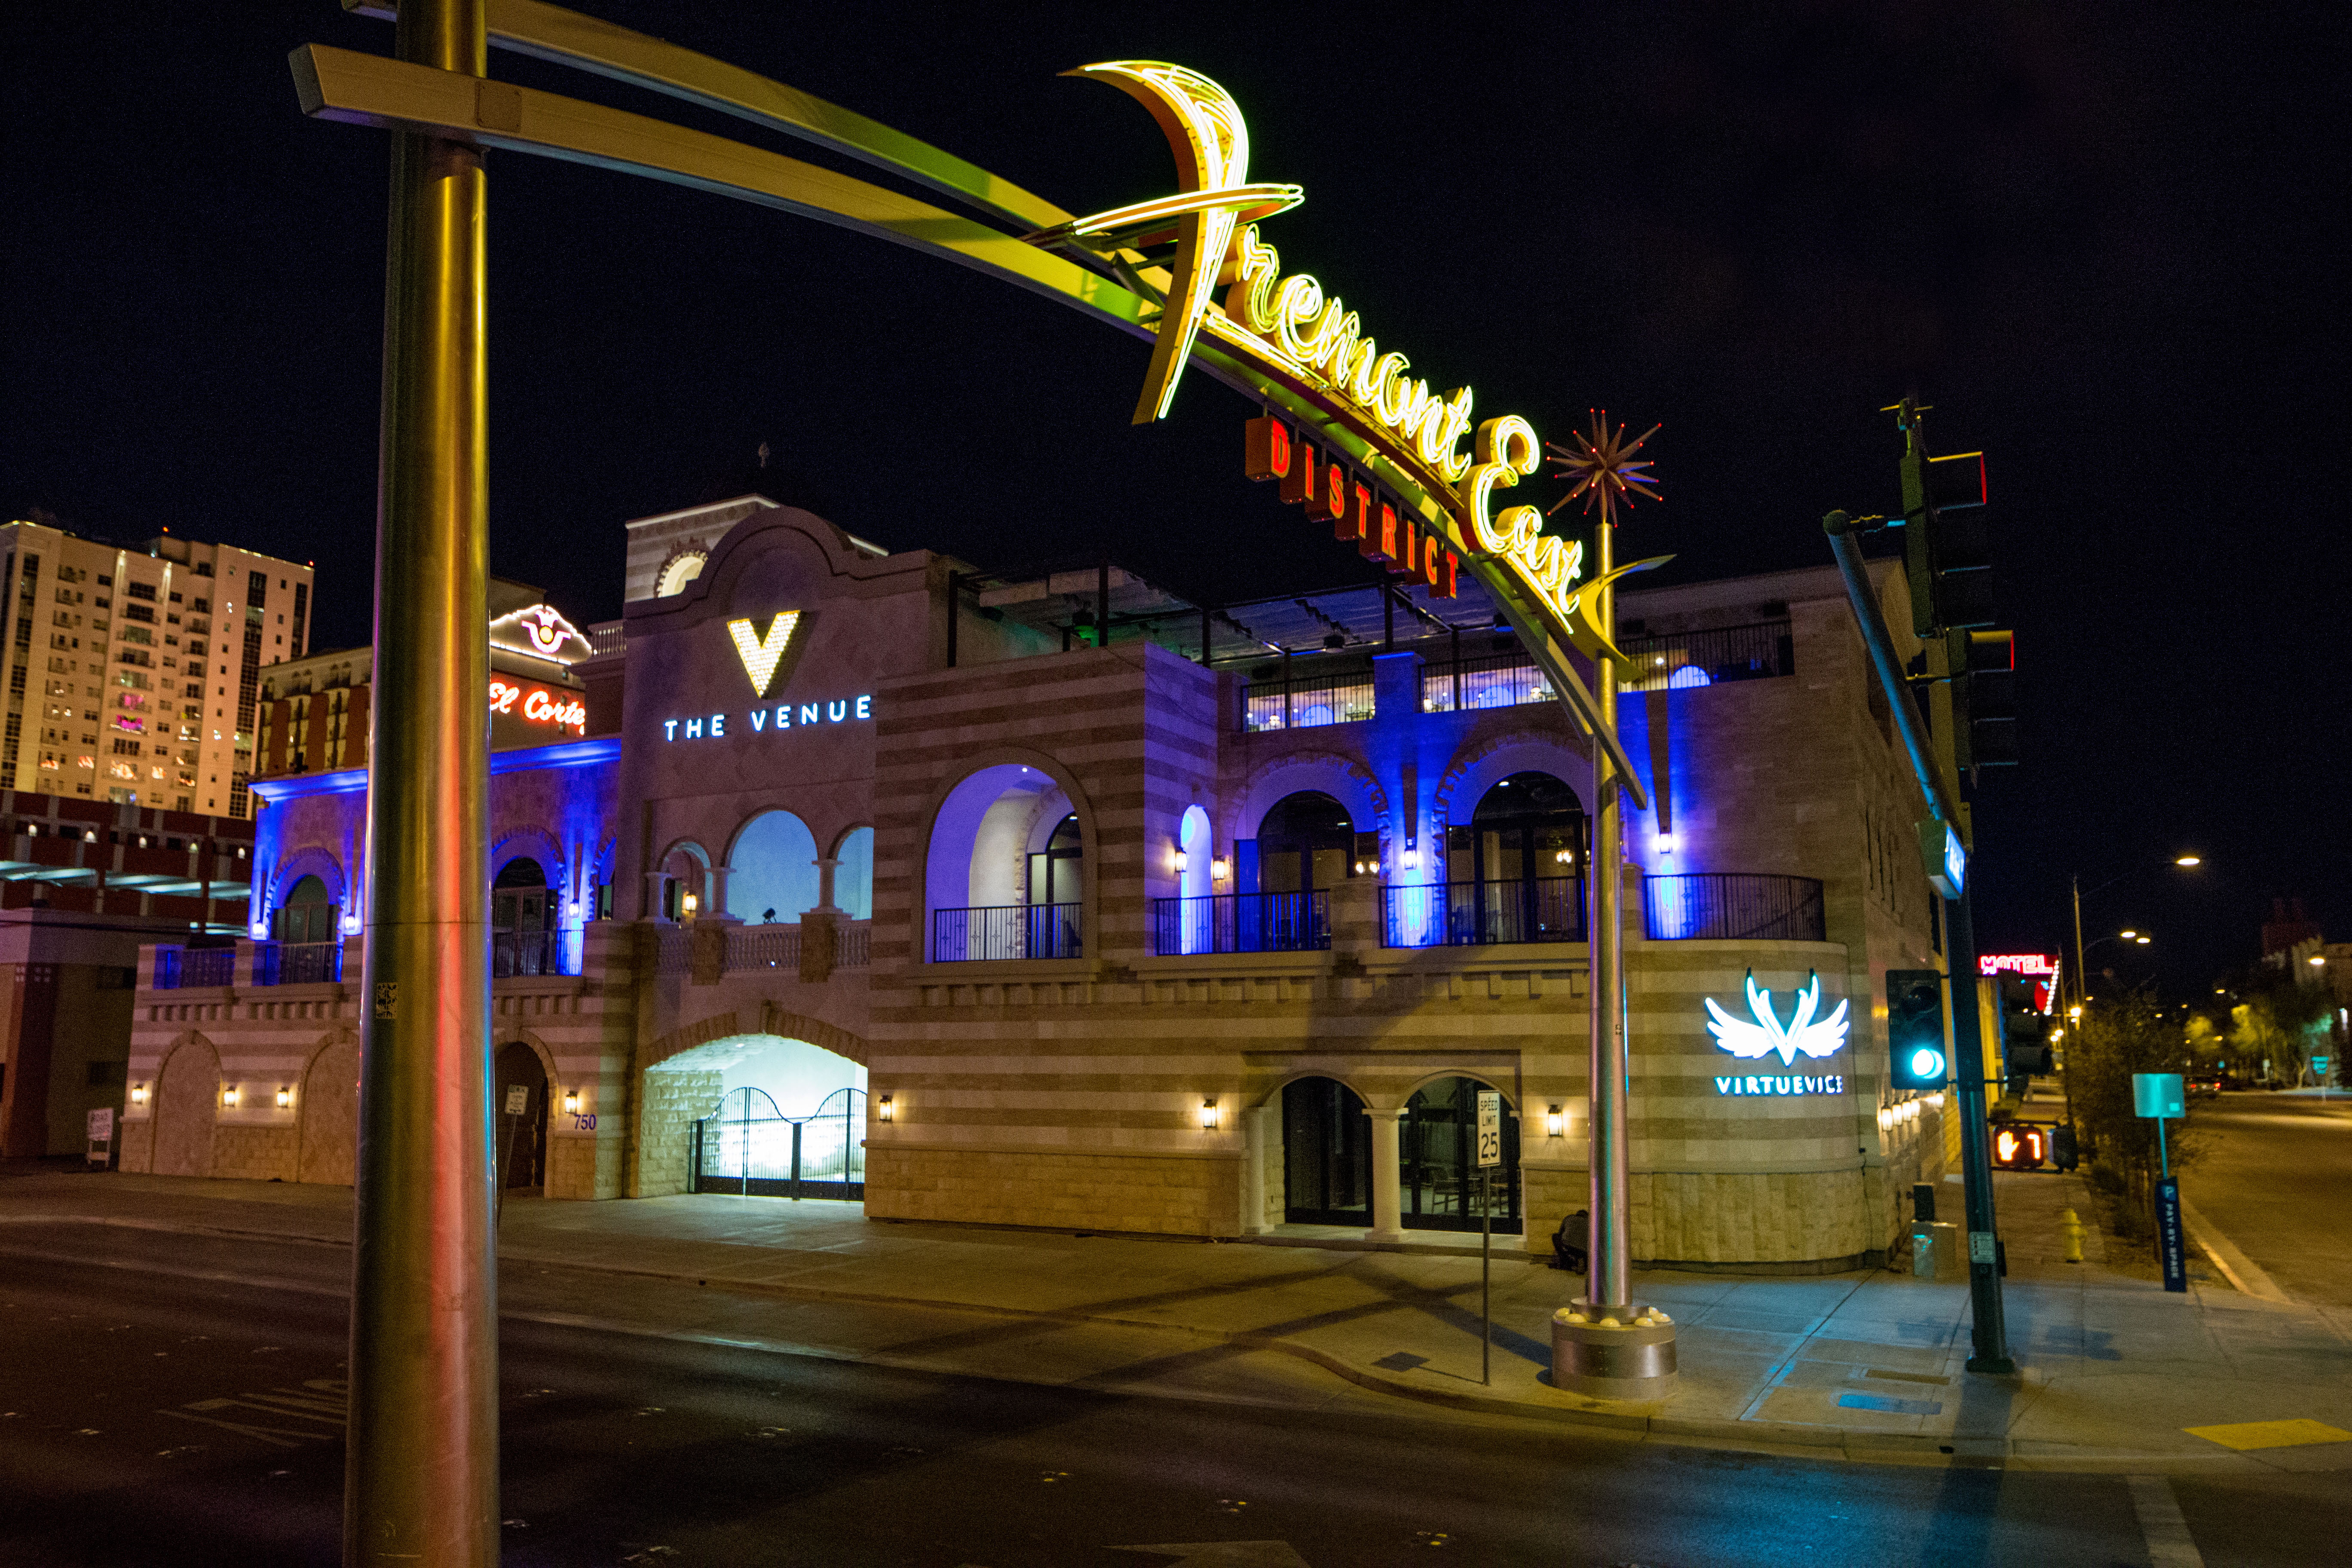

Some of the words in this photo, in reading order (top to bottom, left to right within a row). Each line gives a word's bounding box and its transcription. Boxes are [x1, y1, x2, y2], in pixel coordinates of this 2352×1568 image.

[1070, 59, 1473, 483] Fremont
[1470, 414, 1582, 614] East
[1271, 419, 1458, 599] DISTRICT
[727, 609, 801, 698] V
[524, 690, 585, 735] Corte
[664, 714, 725, 742] THE
[750, 694, 871, 732] VENUE
[574, 1114, 596, 1130] 750
[1480, 1099, 1498, 1111] SPEED
[1482, 1115, 1496, 1126] LIMIT
[1481, 1132, 1498, 1158] 25
[2027, 1133, 2040, 1159] 7
